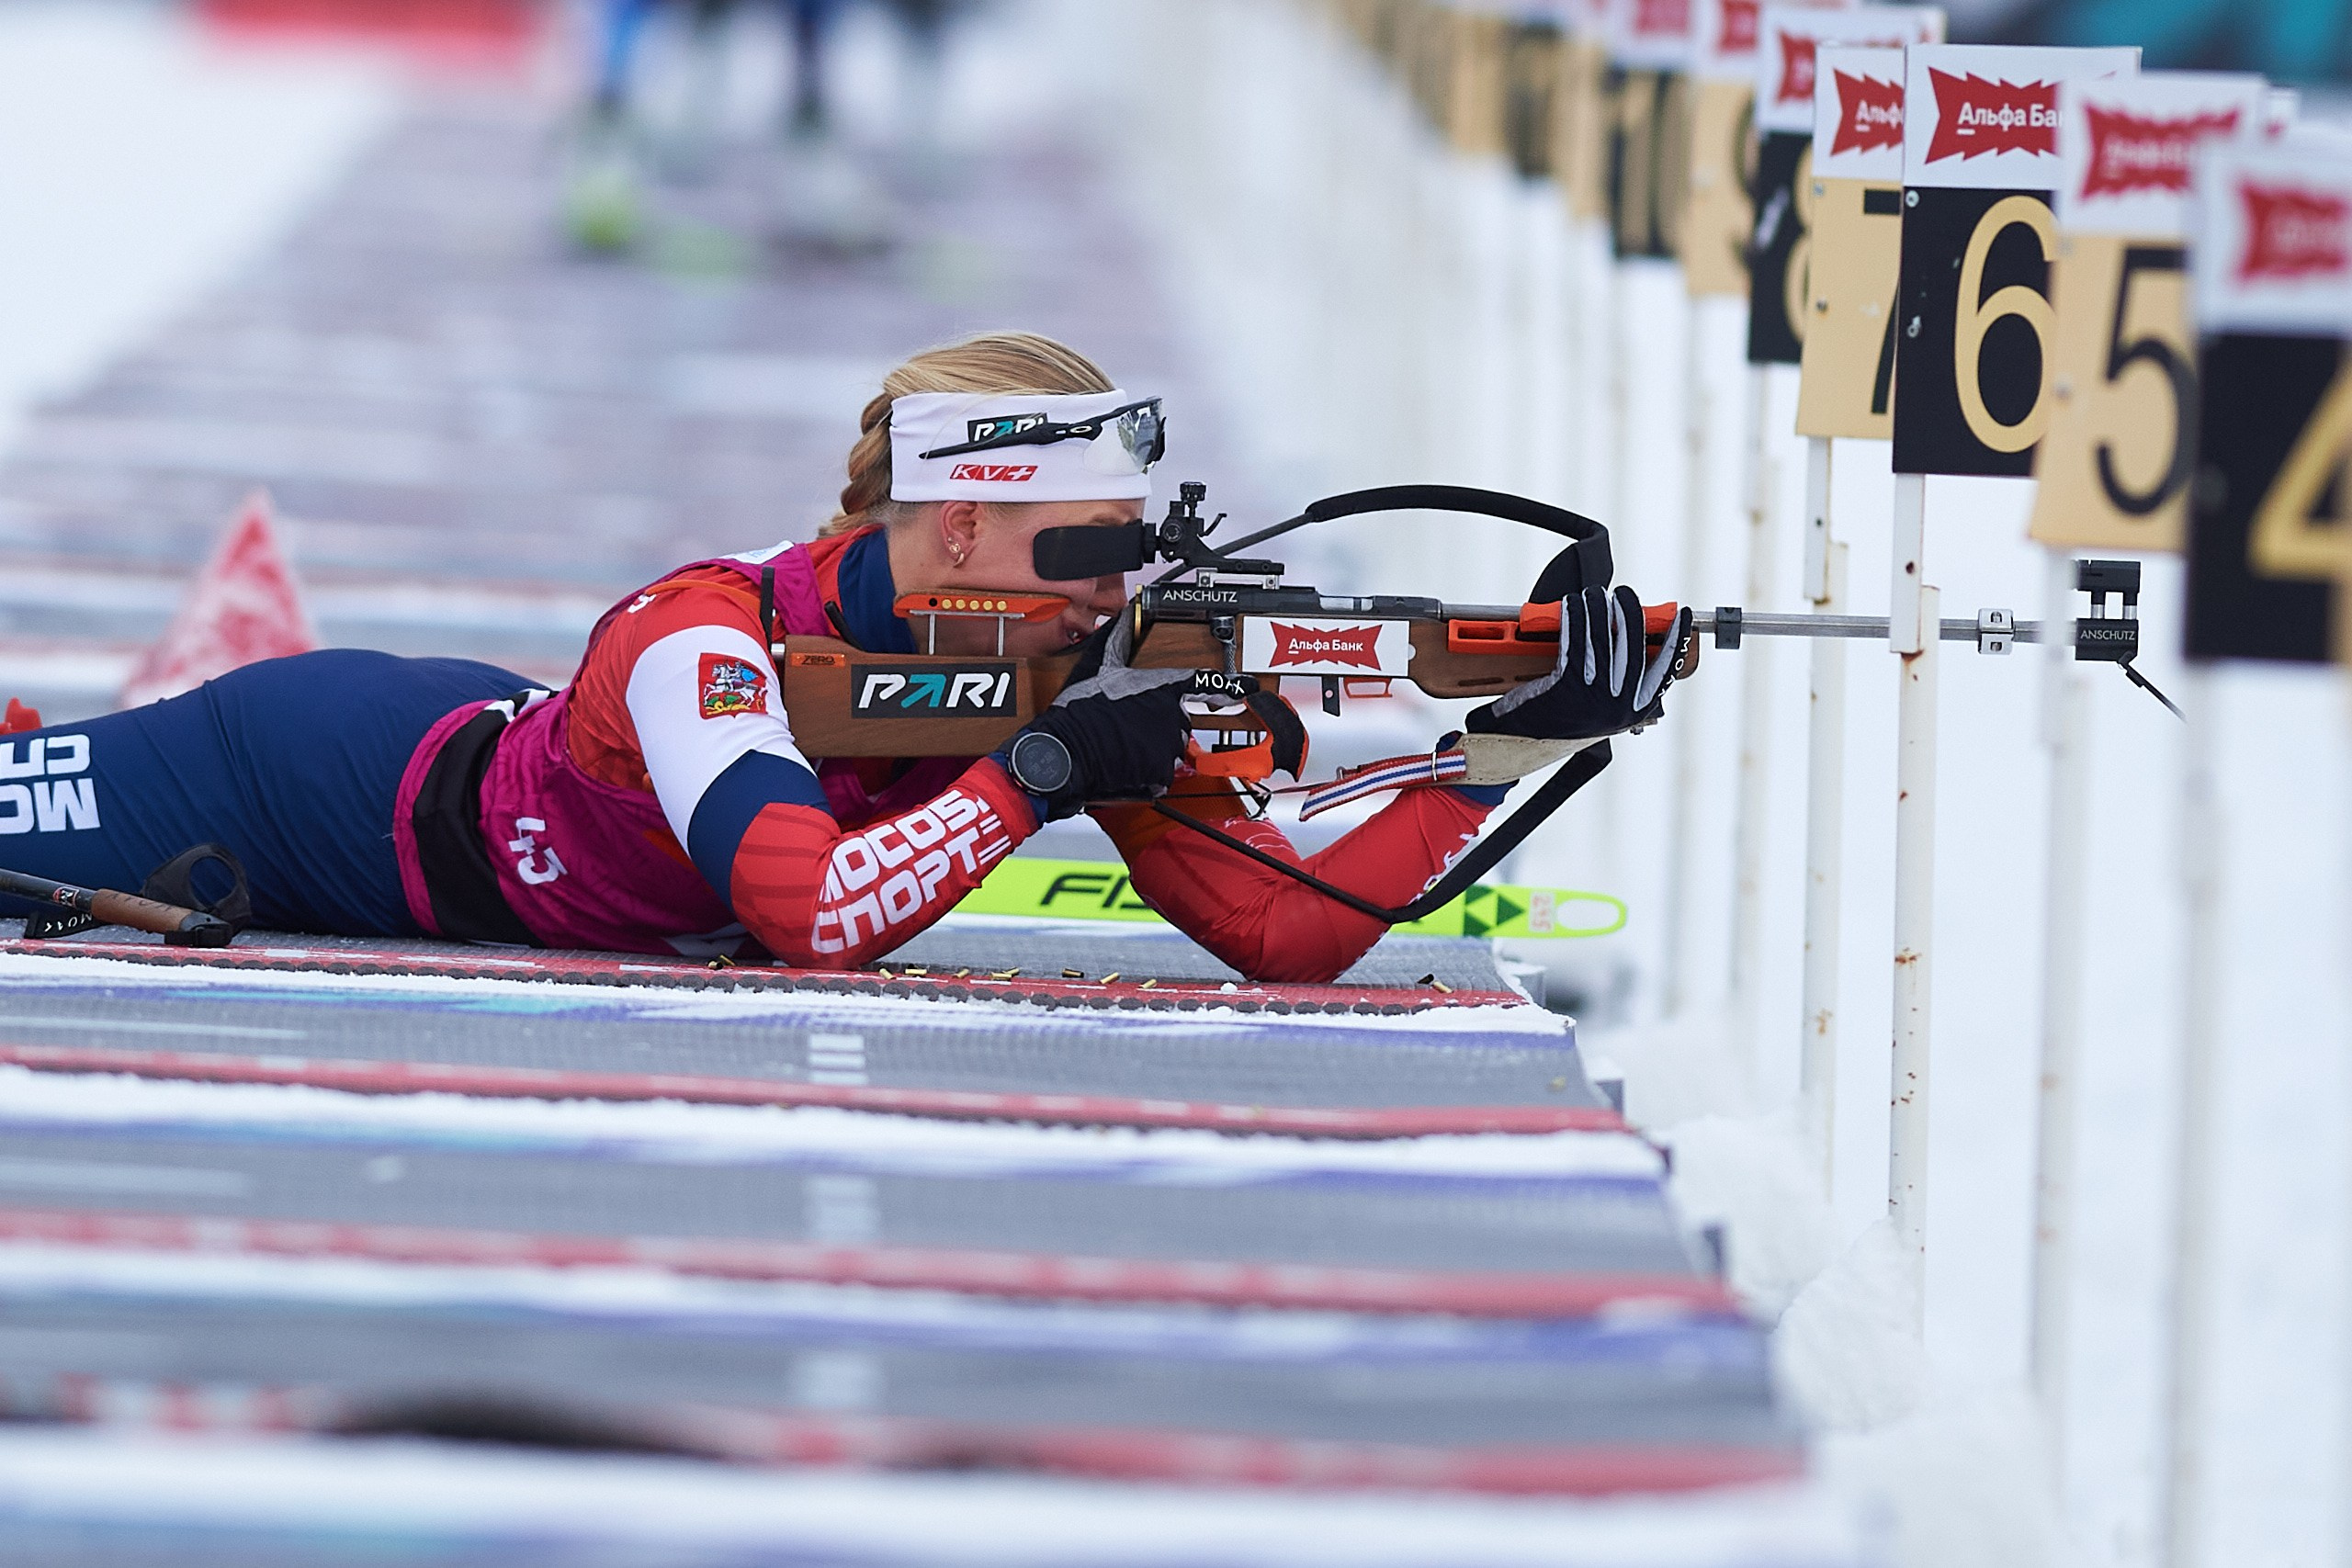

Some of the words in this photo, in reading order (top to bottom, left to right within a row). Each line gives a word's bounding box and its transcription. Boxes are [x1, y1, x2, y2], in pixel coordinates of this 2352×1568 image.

[1856, 100, 1903, 130] Альф
[1957, 102, 2027, 132] Альфа
[2030, 103, 2064, 128] Ба
[1954, 195, 2059, 454] 6
[2095, 248, 2199, 516] 5
[1162, 589, 1238, 603] ANSCHUTZ
[1288, 638, 1330, 654] Альфа
[1332, 639, 1363, 652] Банк
[2080, 629, 2136, 641] ANSCHUTZ
[811, 827, 980, 953] СПОРТ
